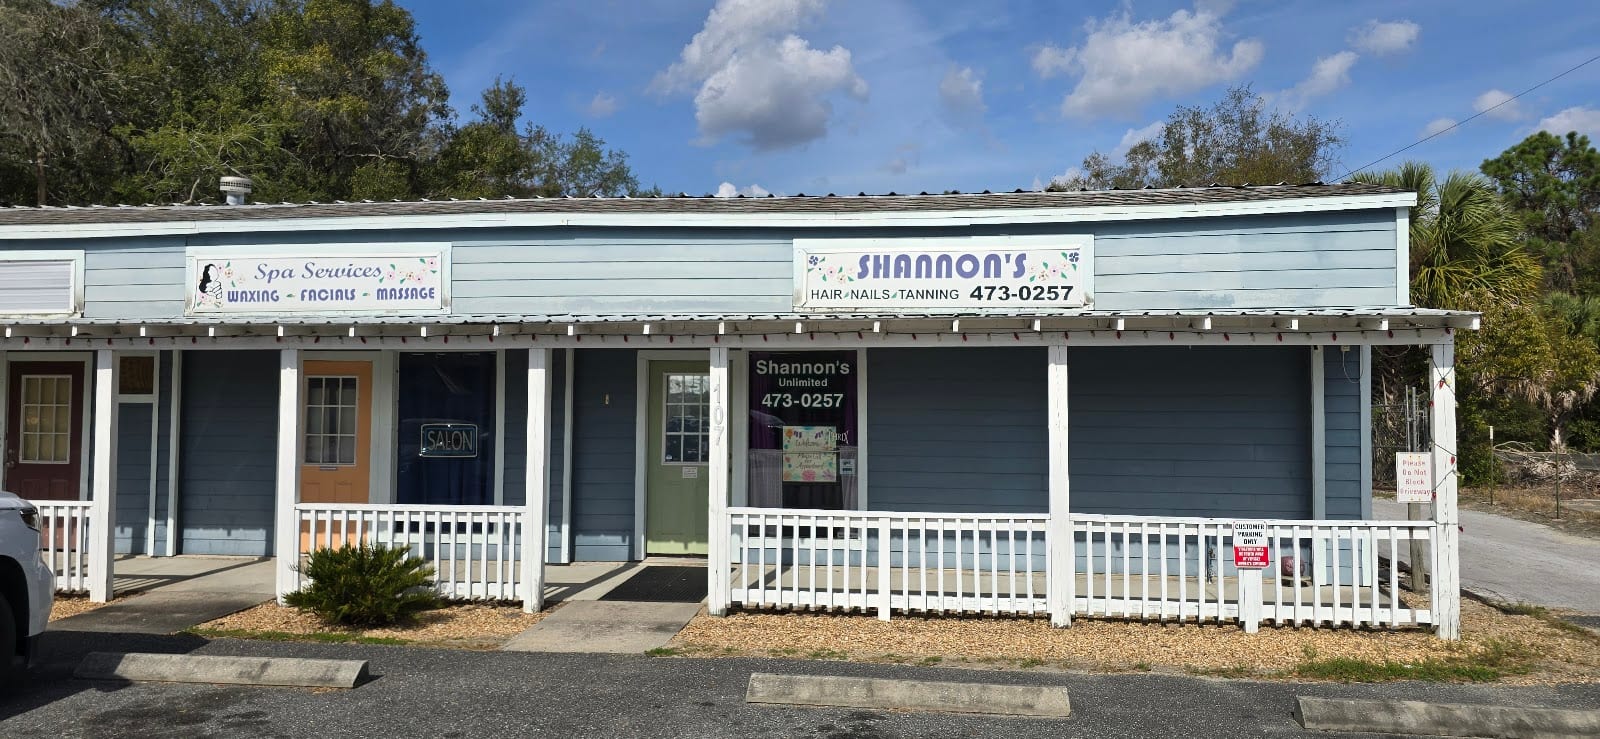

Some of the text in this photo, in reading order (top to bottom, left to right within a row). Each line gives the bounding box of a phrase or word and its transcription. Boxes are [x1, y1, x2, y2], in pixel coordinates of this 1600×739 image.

[254, 261, 382, 283] Spa Services
[857, 252, 1026, 279] SHANNON'S
[227, 287, 435, 303] WAXING FACIALS MASSAGE
[811, 285, 1074, 301] HAIR NAILS TANNING 473-0257
[756, 359, 850, 375] Shannon's
[778, 378, 828, 387] Unlimited
[762, 393, 844, 408] 473-0257
[427, 430, 473, 451] SALON
[1402, 459, 1426, 467] Please
